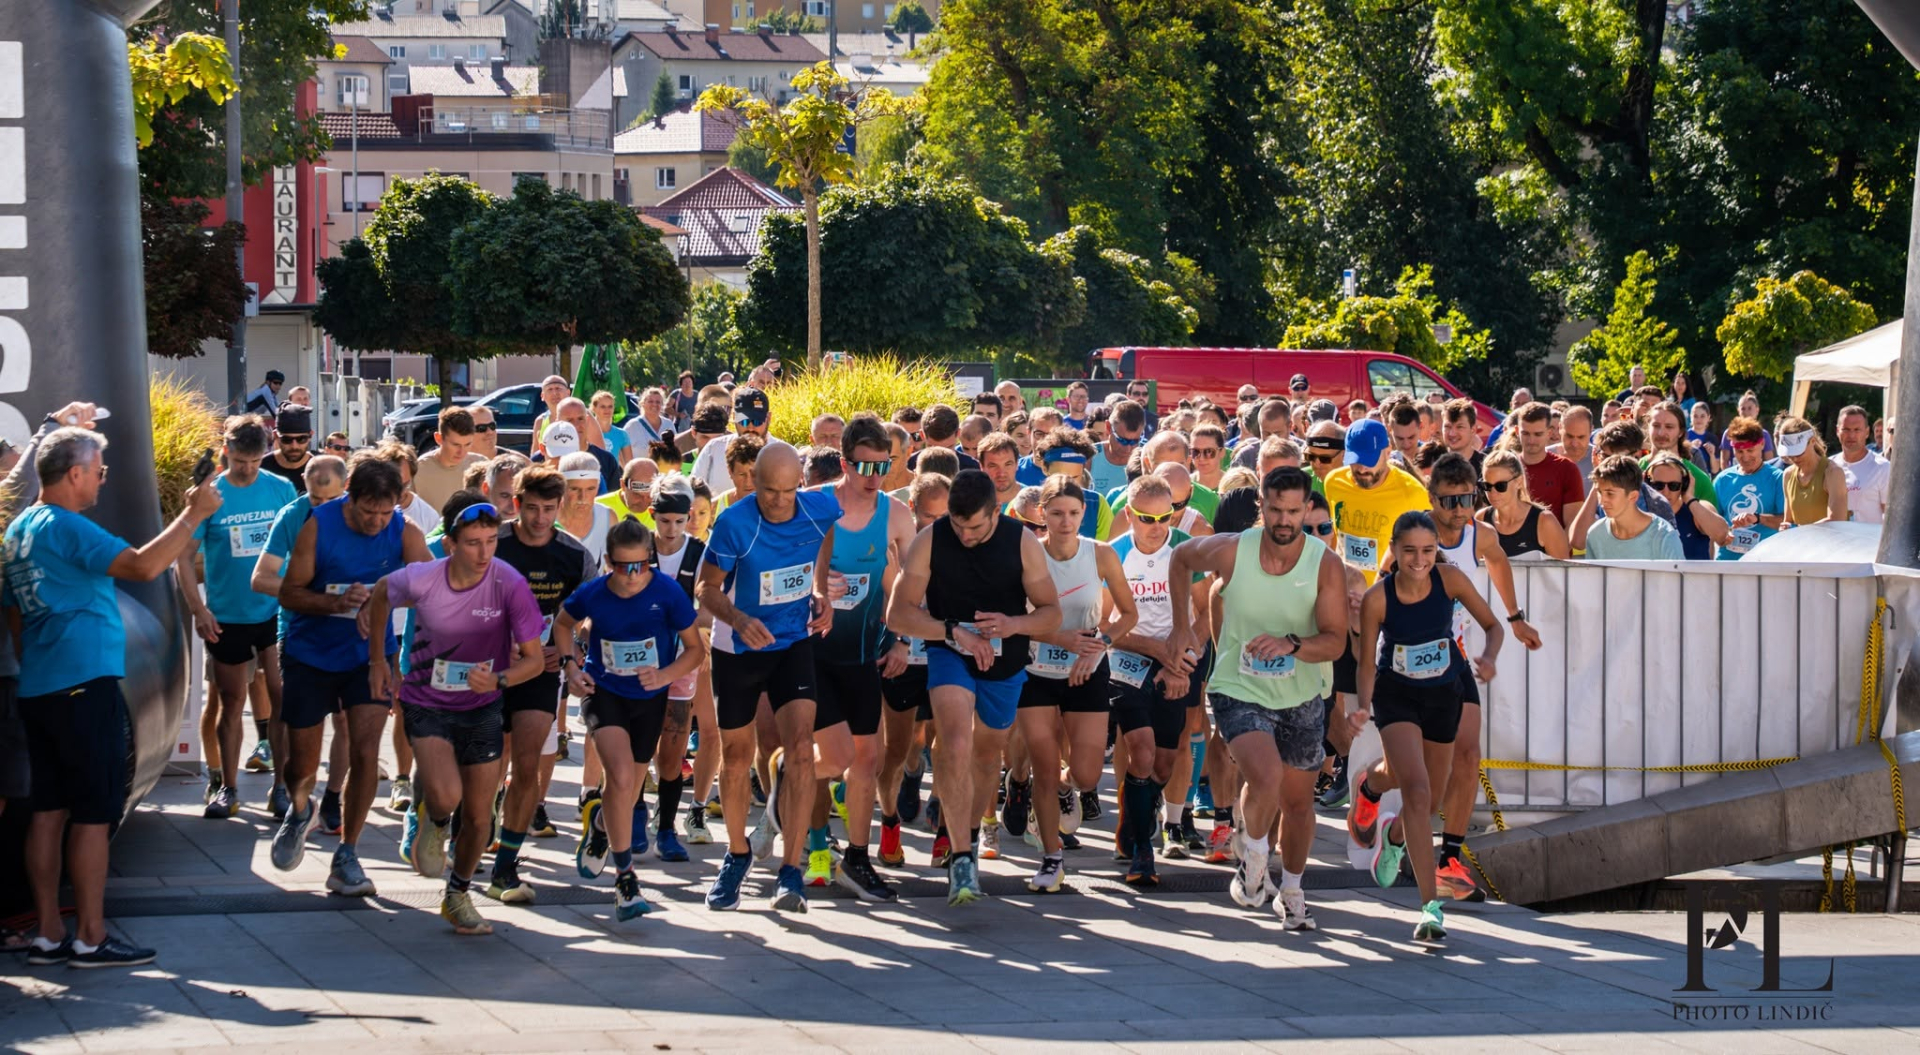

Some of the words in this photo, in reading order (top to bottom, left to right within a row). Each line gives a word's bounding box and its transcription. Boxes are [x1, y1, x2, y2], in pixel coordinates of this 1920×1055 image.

[250, 531, 269, 543] 180
[1739, 535, 1753, 544] 122
[1351, 545, 1369, 558] 166
[783, 575, 804, 589] 126
[624, 650, 647, 663] 212
[1047, 649, 1069, 661] 136
[1414, 651, 1442, 667] 204
[1118, 657, 1139, 673] 195
[1263, 657, 1285, 668] 172
